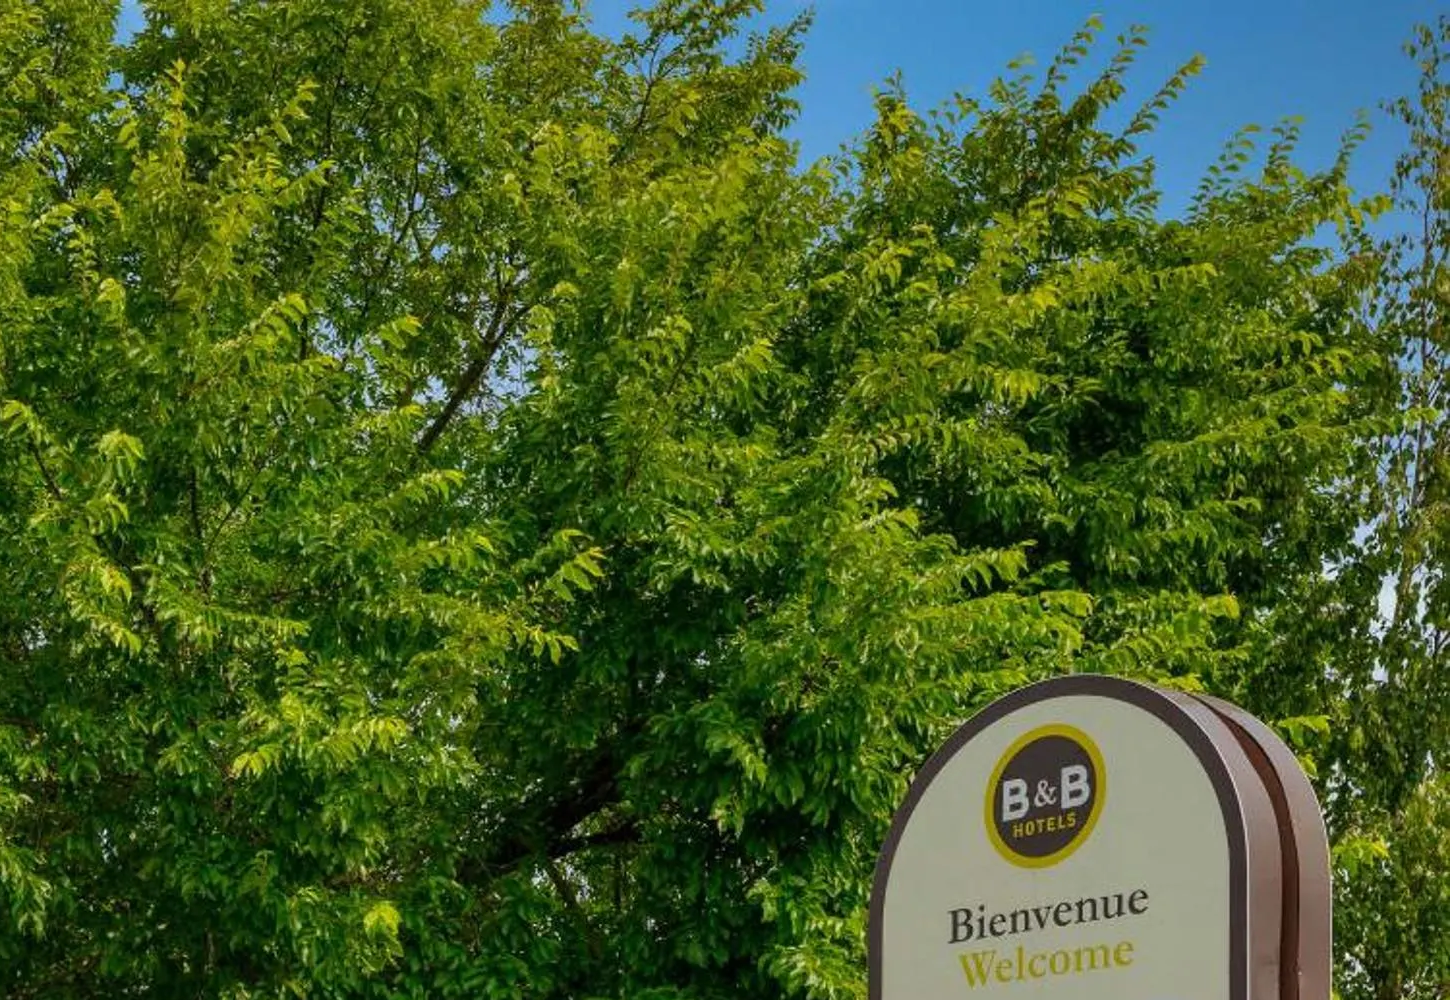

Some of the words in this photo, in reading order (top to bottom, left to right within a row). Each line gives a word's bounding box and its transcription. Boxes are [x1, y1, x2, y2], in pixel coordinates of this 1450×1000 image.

[1002, 764, 1090, 822] B&B
[1012, 811, 1077, 838] HOTELS
[948, 889, 1149, 944] Bienvenue
[958, 941, 1135, 989] Welcome
